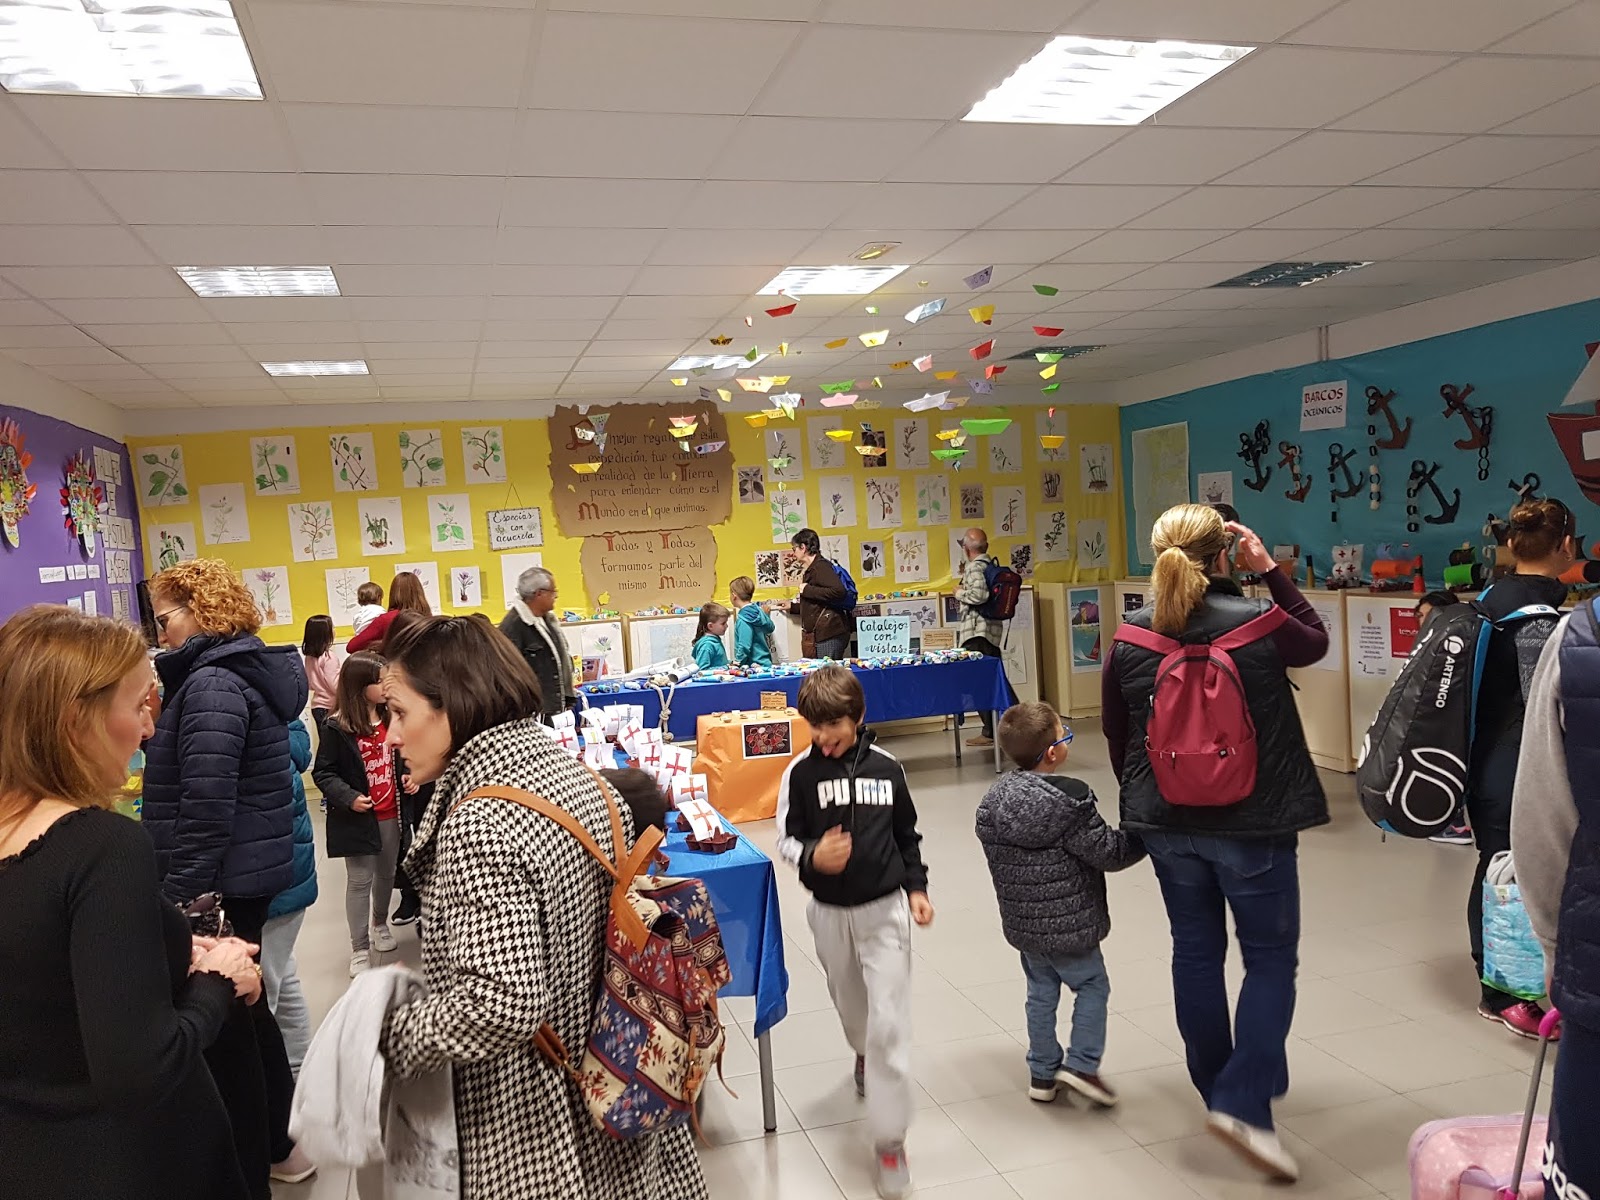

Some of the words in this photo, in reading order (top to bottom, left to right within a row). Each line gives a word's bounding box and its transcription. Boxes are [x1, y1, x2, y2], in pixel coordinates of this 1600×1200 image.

[1304, 388, 1343, 403] BARCOS
[609, 433, 637, 446] mejor
[701, 427, 719, 440] esta
[652, 451, 667, 462] fue
[594, 466, 636, 481] realidad
[643, 466, 655, 480] de
[660, 465, 669, 479] la
[590, 489, 616, 502] para
[621, 481, 662, 496] entender
[699, 486, 710, 494] es
[711, 479, 720, 493] el
[578, 501, 626, 520] Mundo
[629, 509, 640, 517] en
[641, 502, 649, 515] el
[654, 507, 670, 520] que
[496, 531, 536, 543] acuarela
[602, 535, 640, 551] Todos
[646, 541, 654, 554] y
[658, 532, 696, 549] Todas
[601, 557, 653, 573] formamos
[659, 555, 685, 577] parte
[688, 554, 703, 569] del
[618, 580, 648, 591] mismo
[658, 574, 701, 590] Mundo.
[860, 619, 905, 634] Catalejo
[874, 633, 892, 641] con
[870, 643, 904, 654] vistas
[1435, 655, 1456, 709] ARTENGO
[817, 777, 894, 810] PUMA
